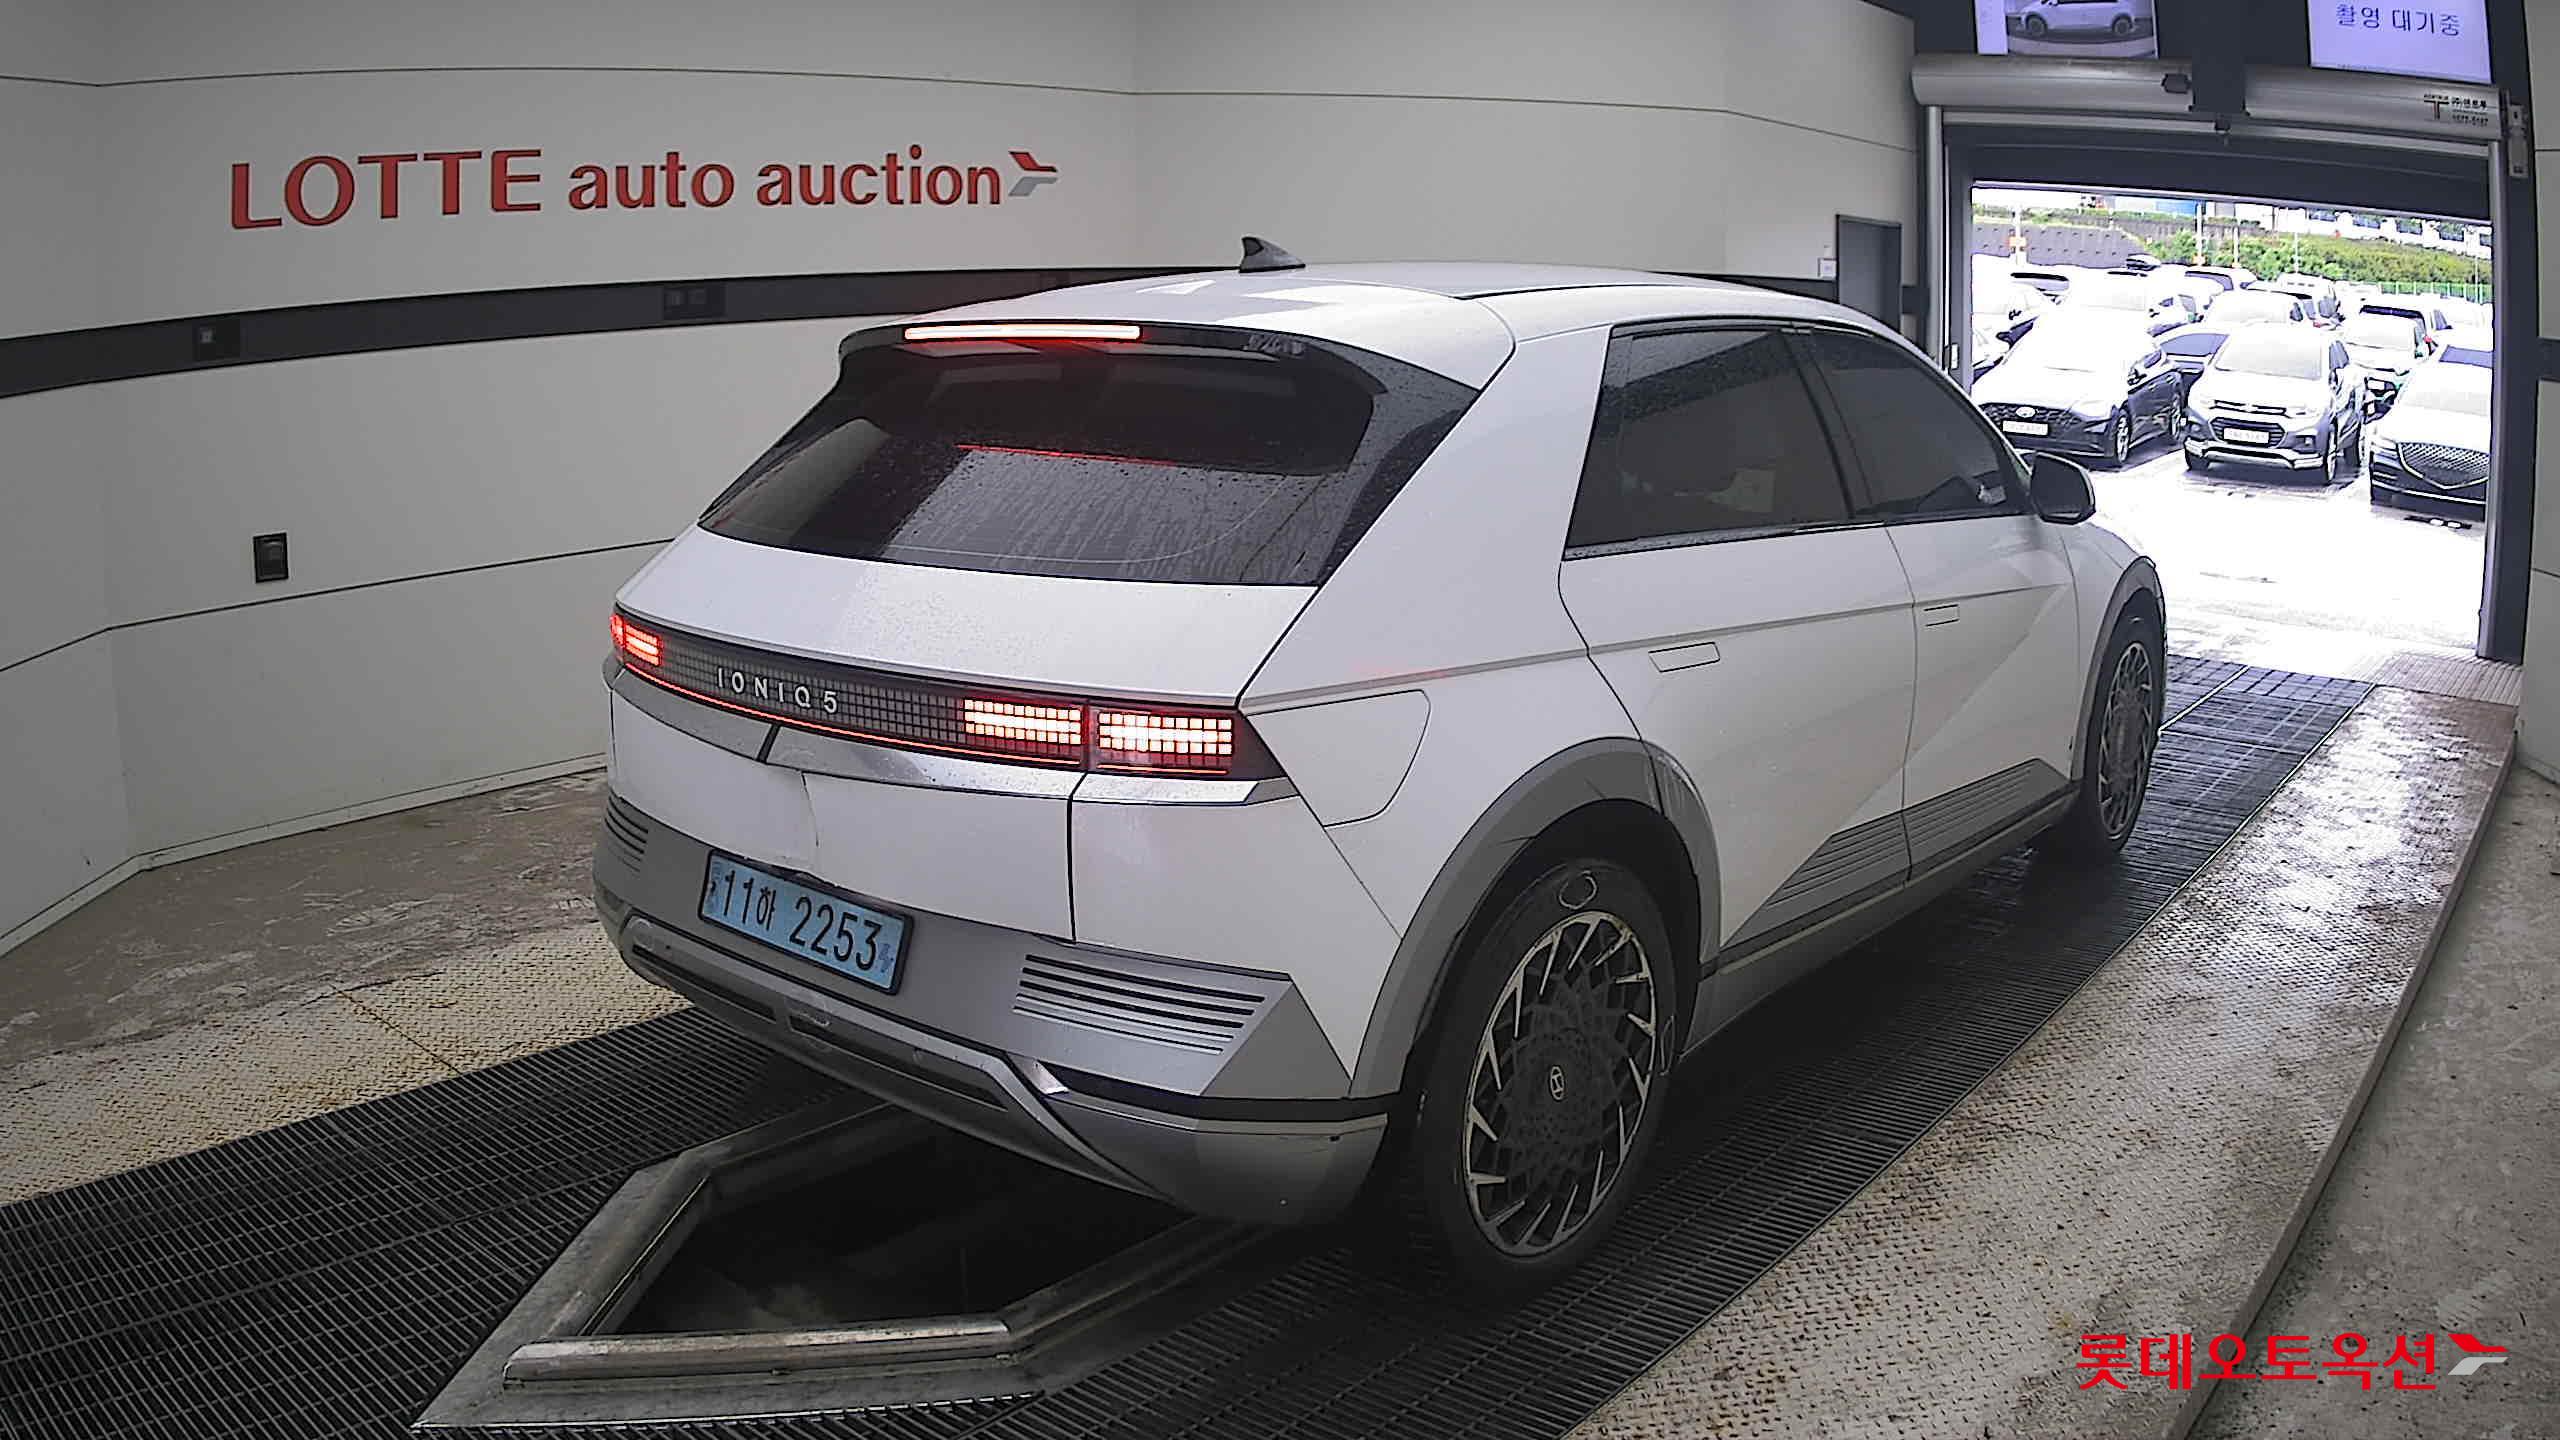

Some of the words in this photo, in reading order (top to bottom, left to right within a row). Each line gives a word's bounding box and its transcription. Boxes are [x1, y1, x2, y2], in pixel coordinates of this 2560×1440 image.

[231, 149, 542, 230] LOTTE
[568, 151, 736, 209] auto
[756, 145, 1001, 206] auction
[717, 666, 812, 709] IONIQ
[822, 689, 839, 714] 5
[723, 869, 778, 931] 11하
[789, 895, 883, 971] 2253
